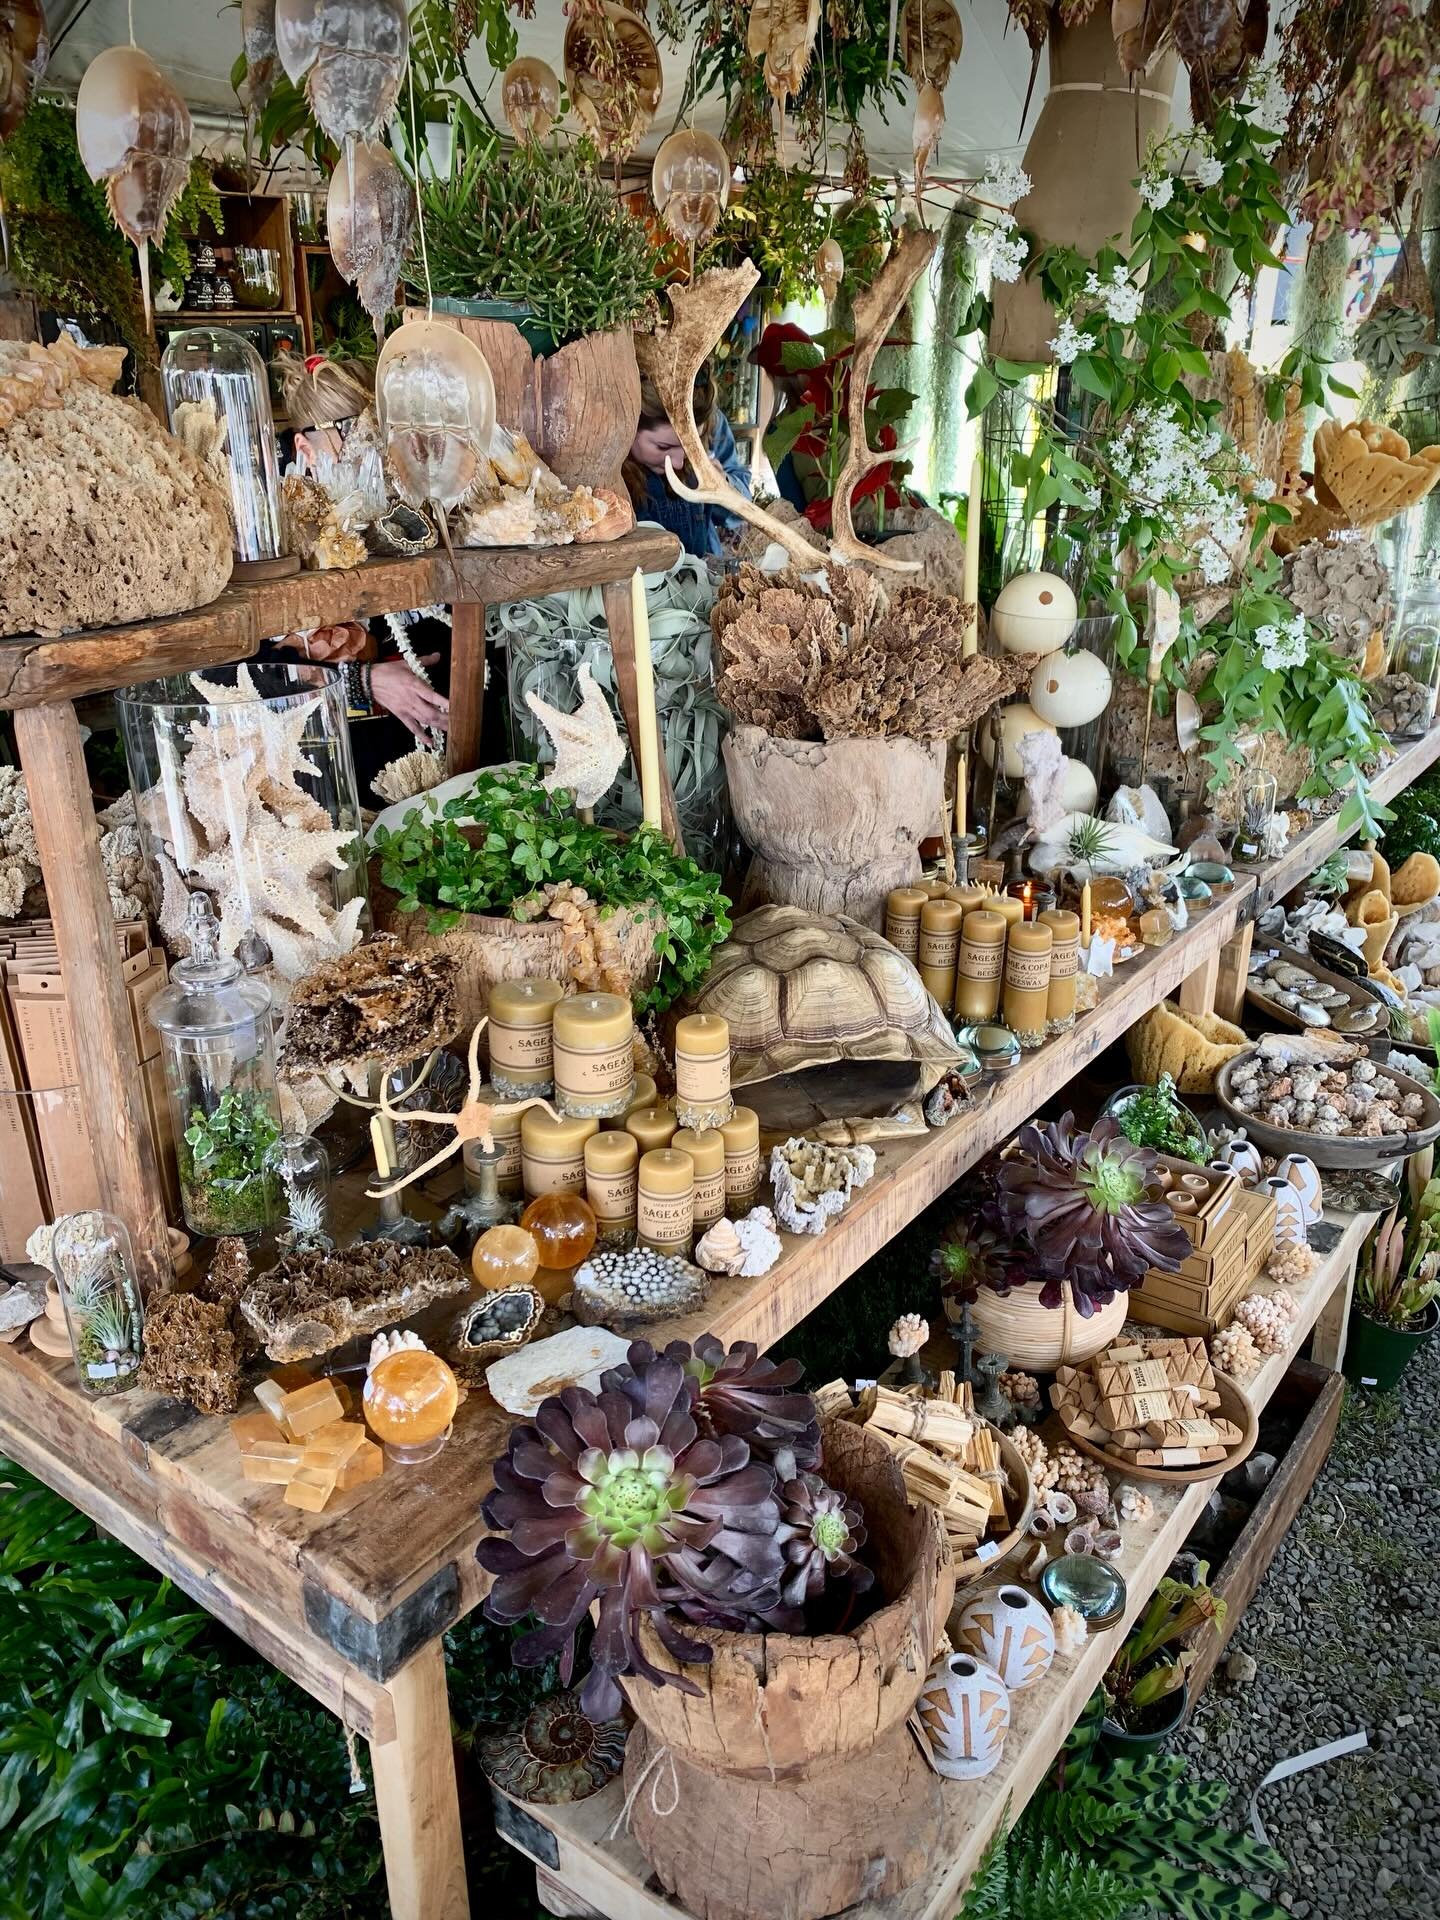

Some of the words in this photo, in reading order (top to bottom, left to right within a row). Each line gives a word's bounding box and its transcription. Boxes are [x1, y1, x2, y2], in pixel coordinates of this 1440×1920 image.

[927, 942, 950, 950] SAGE
[967, 952, 990, 962] SAGE
[1028, 962, 1049, 972] COPA
[518, 1037, 547, 1048] SAGE
[592, 1059, 620, 1073] SAGE
[562, 1170, 585, 1182] SAG
[725, 1165, 744, 1175] AGE
[607, 1184, 636, 1198] SAGE
[694, 1188, 717, 1200] AGE
[642, 1206, 671, 1219] SAGE
[656, 1225, 692, 1238] BEESWA
